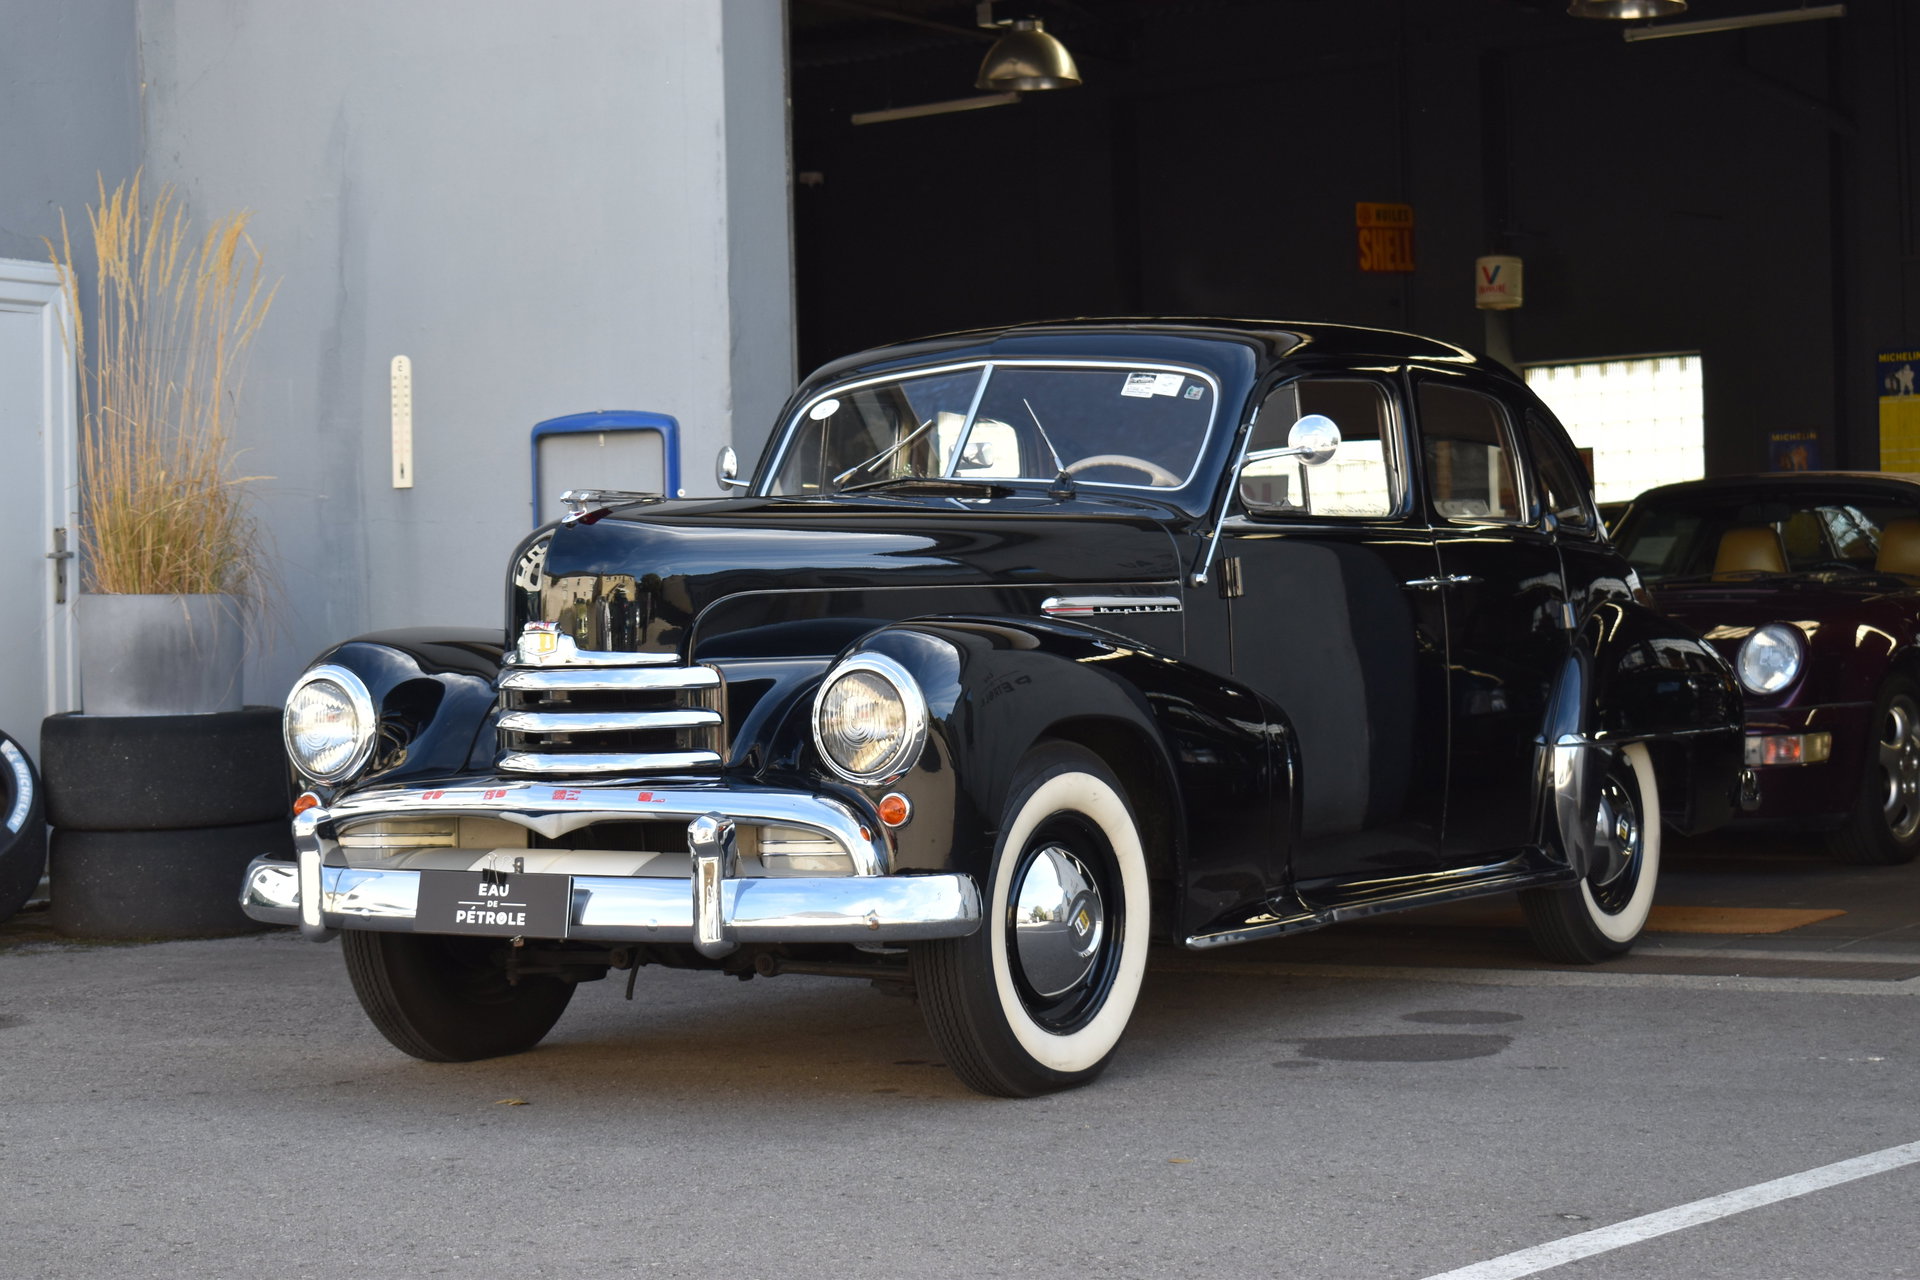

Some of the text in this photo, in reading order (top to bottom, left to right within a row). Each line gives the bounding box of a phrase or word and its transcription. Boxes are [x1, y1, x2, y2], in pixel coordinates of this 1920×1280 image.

[1359, 228, 1415, 272] SHELL
[1771, 432, 1817, 441] MICHELIN
[12, 762, 30, 826] MICHELIN
[478, 883, 510, 897] EAU
[487, 900, 498, 908] DE
[456, 906, 526, 926] PÉTROLE
